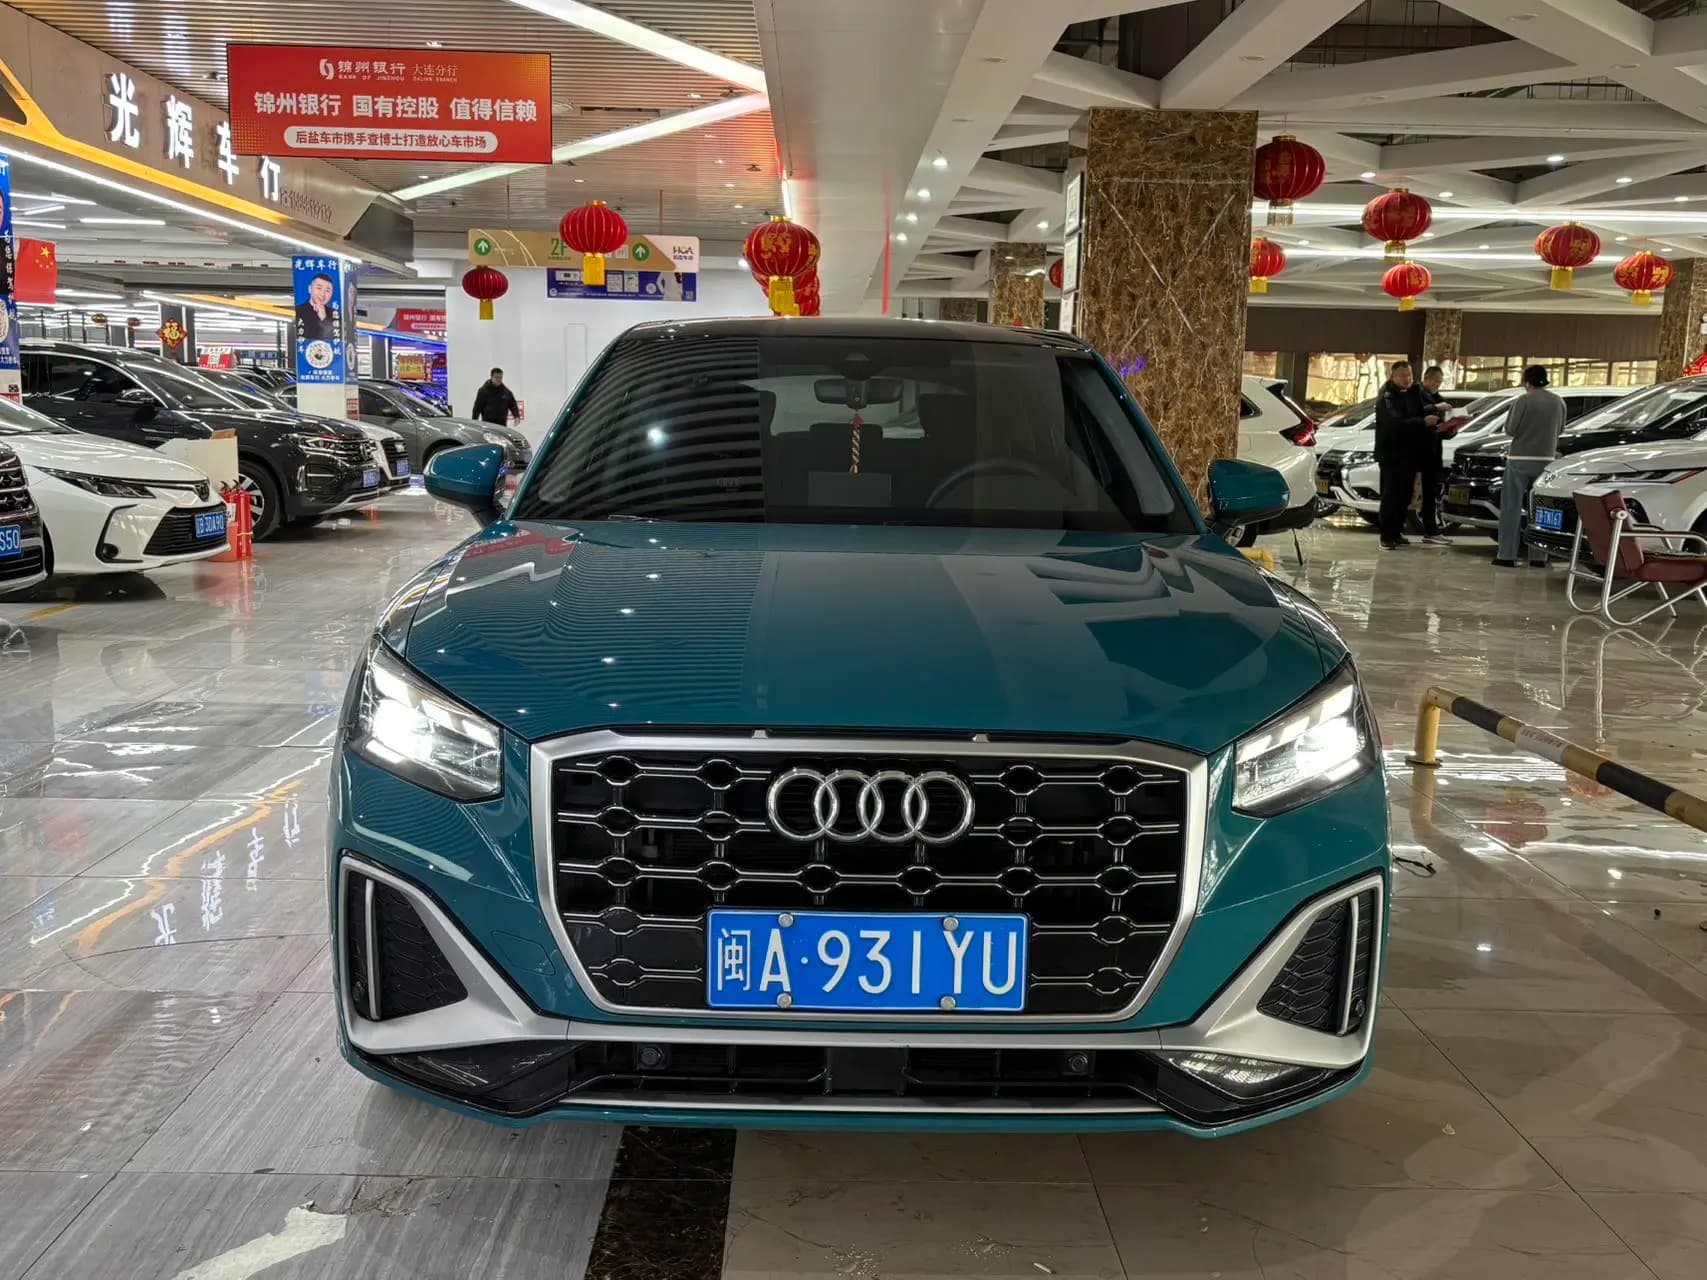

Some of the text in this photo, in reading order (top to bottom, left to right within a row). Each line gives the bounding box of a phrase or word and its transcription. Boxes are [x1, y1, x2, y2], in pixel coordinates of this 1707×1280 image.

[338, 60, 457, 77] 锦州银行 大连分行
[254, 91, 538, 122] 锦州银行 国有控股 值得信赖
[295, 130, 487, 149] 后盐车市携手查博士打造放心车市场
[716, 927, 1018, 996] 闽A·931YU
